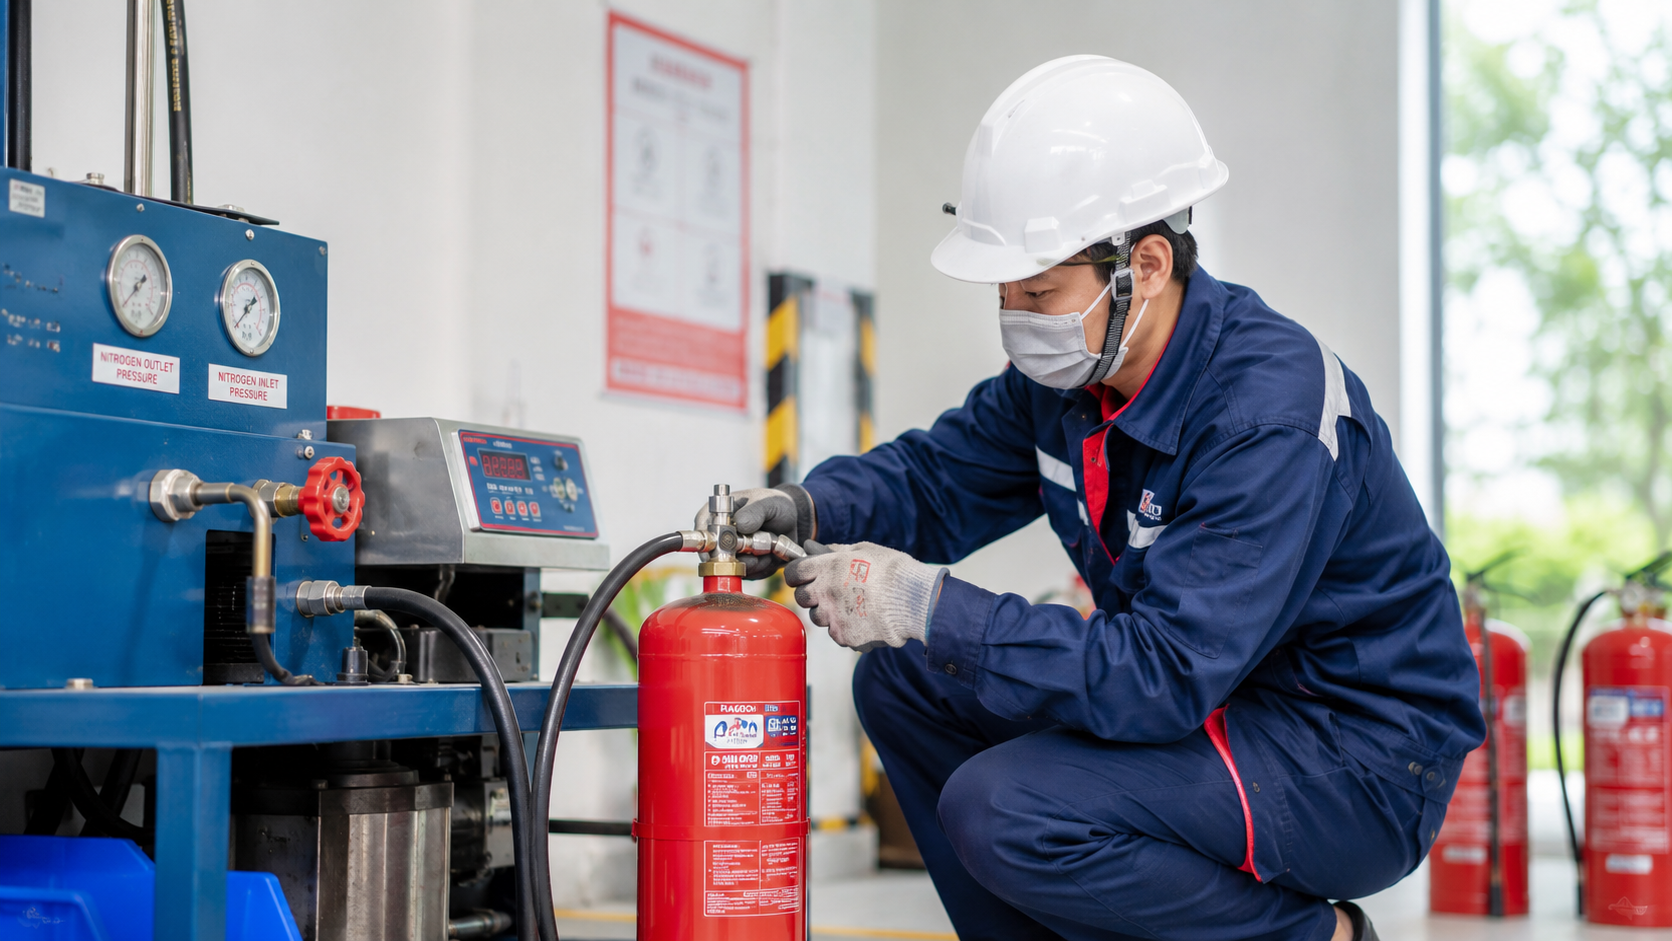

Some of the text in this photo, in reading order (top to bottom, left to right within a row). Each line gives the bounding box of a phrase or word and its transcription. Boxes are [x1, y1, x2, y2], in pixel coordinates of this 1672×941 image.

[100, 351, 174, 373] NITROGEN OUTLET
[117, 368, 158, 385] PRESSURE
[218, 371, 279, 389] NITROGEN INLET
[229, 386, 268, 401] PRESSURE
